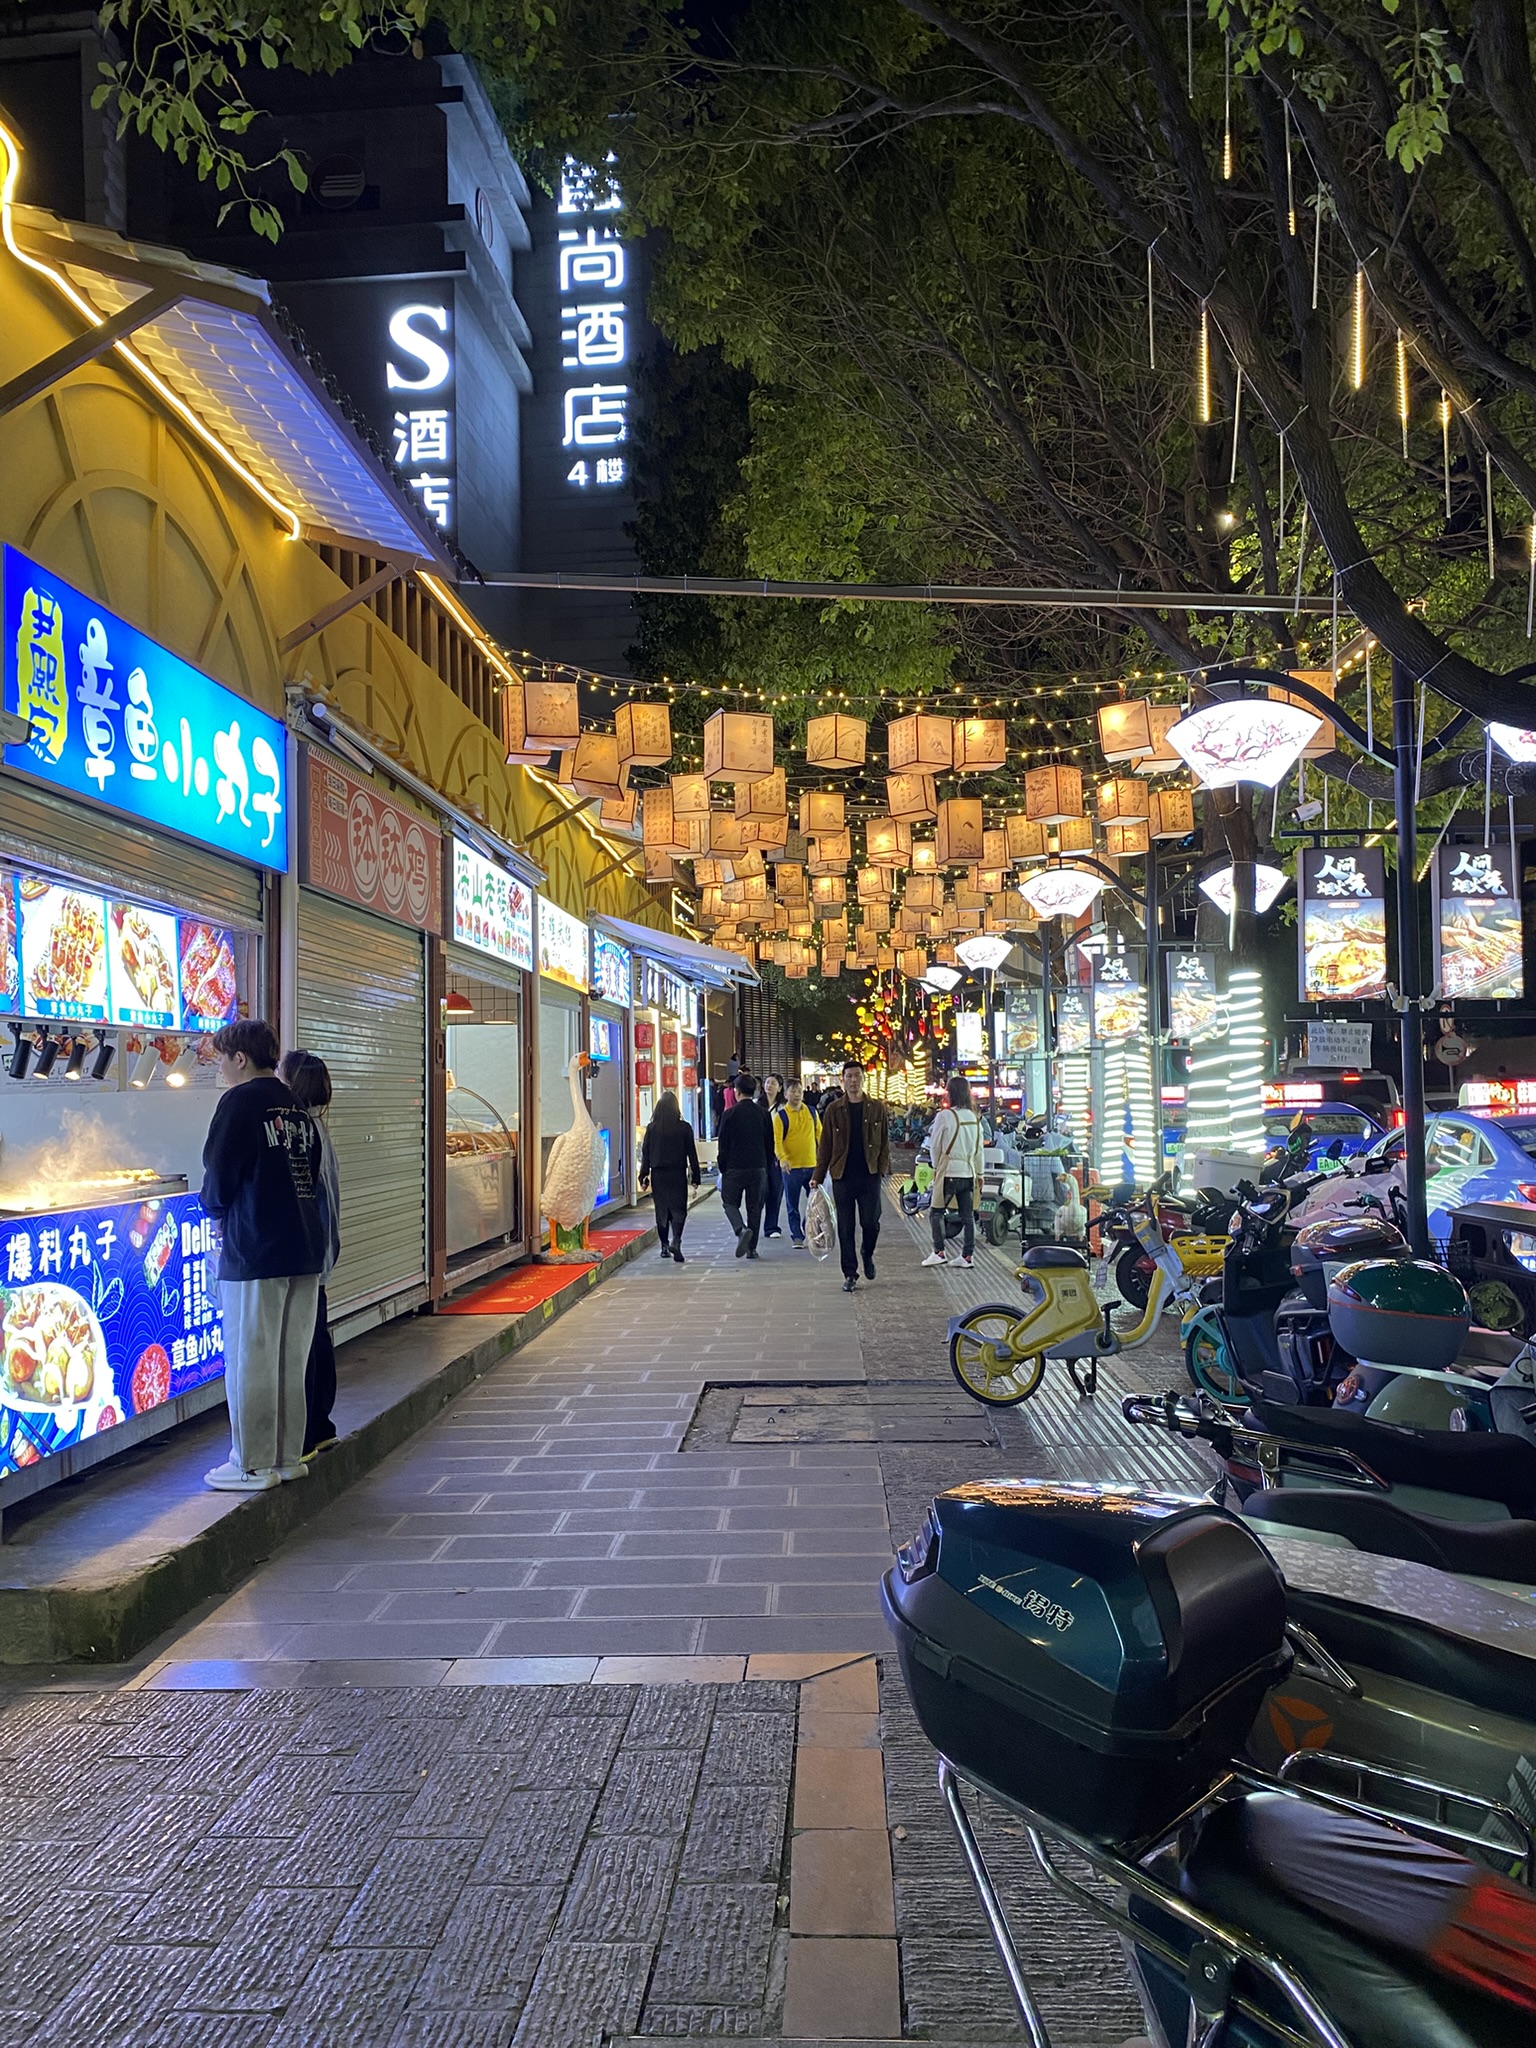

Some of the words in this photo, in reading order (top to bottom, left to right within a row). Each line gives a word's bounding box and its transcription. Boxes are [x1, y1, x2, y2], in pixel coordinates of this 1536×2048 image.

[386, 304, 451, 391] S
[567, 457, 623, 487] 4楼
[76, 618, 282, 848] 章鱼小丸子
[352, 802, 428, 897] 钵钵鸡
[6, 1219, 117, 1282] 爆料丸子
[1021, 1589, 1075, 1632] 锡特
